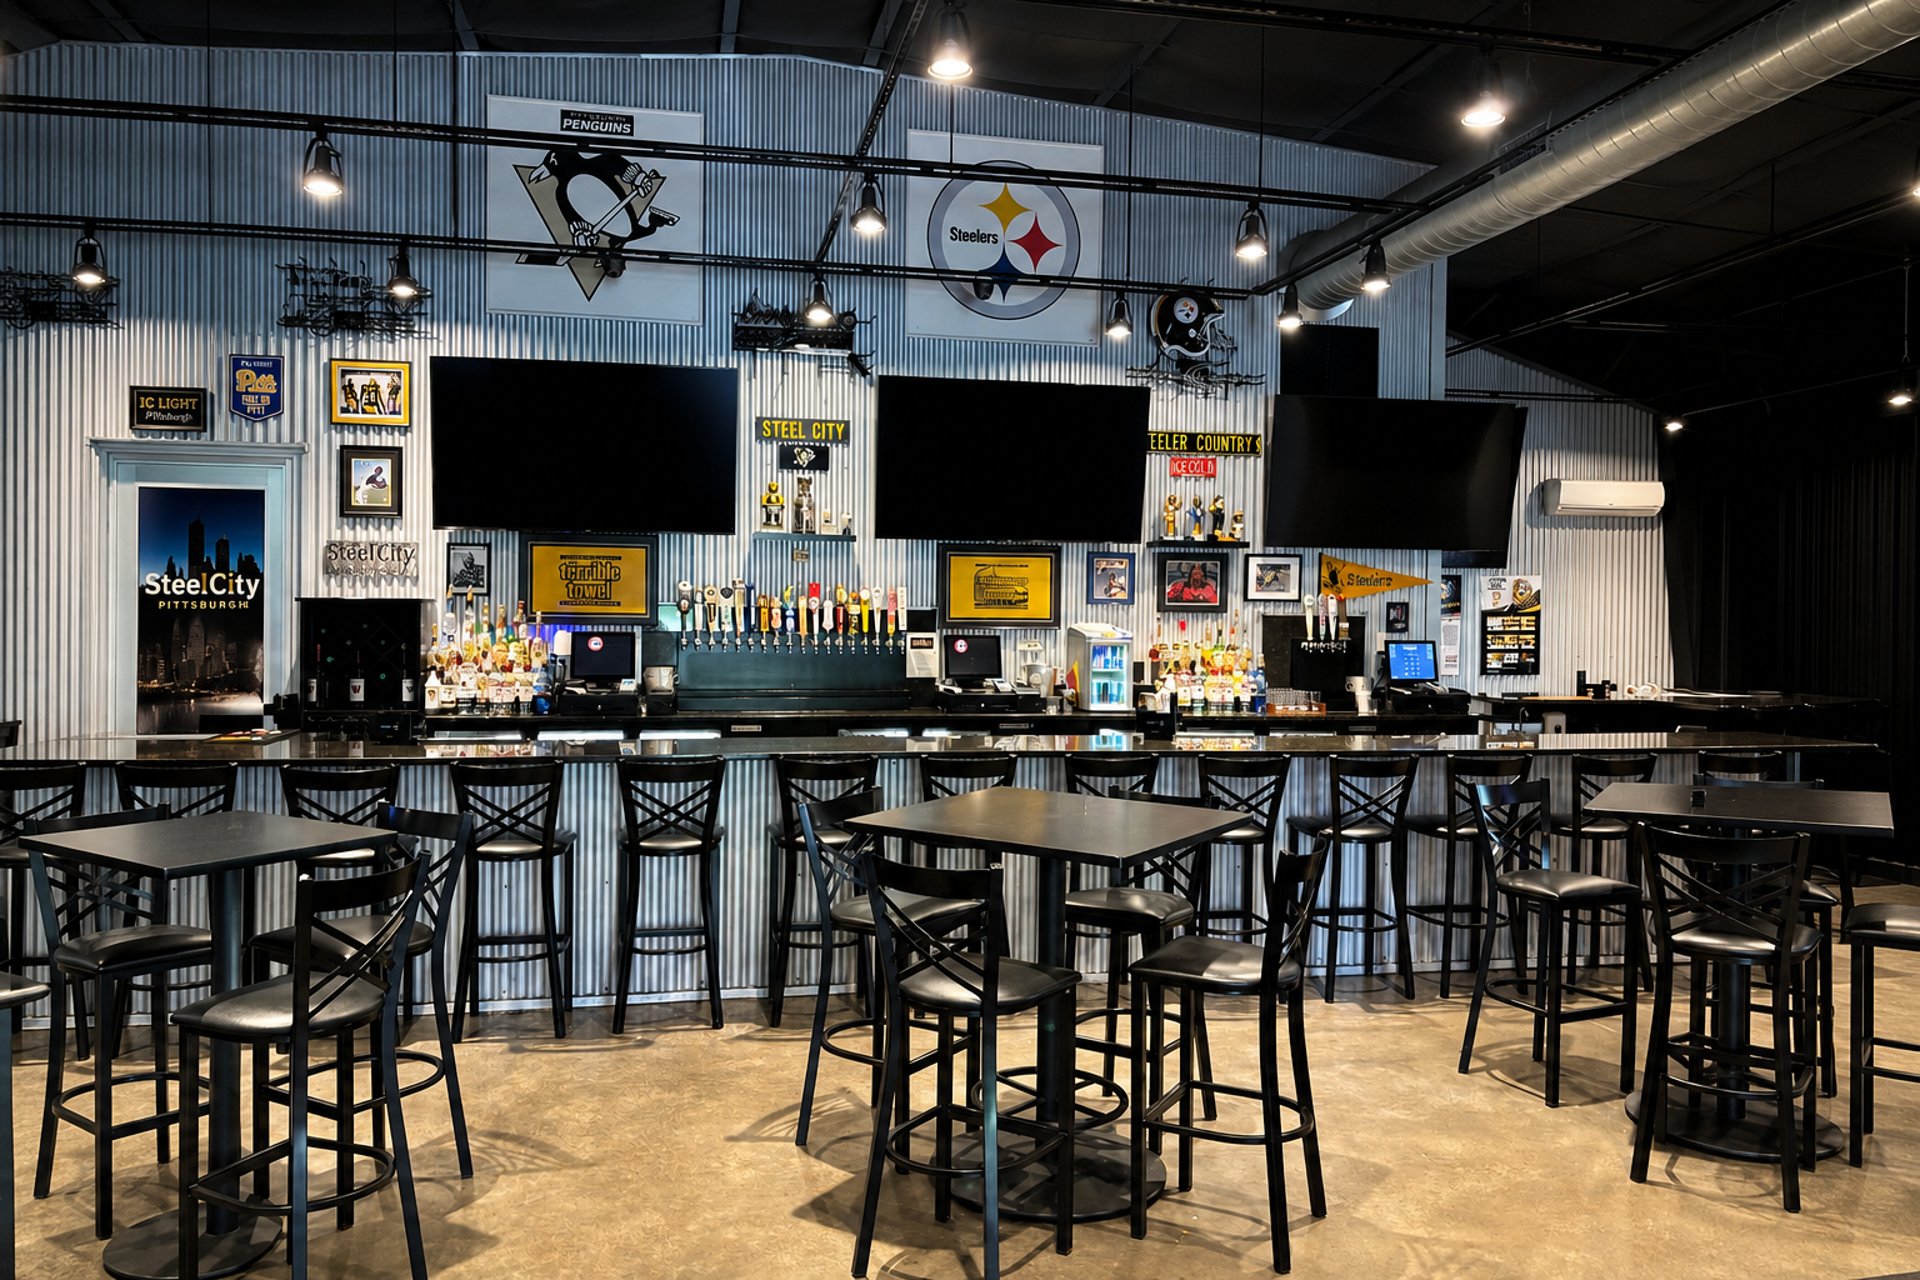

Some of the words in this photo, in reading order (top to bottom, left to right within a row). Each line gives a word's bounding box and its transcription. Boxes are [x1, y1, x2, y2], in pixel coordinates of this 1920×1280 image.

[562, 118, 632, 134] PENGUINS
[949, 226, 999, 245] Steelers
[139, 396, 155, 409] IC
[158, 397, 199, 410] LIGHT
[762, 419, 806, 439] STEEL
[811, 421, 845, 440] CITY
[1148, 433, 1188, 450] EELER
[1196, 434, 1253, 452] COUNTRY
[565, 581, 612, 600] towel
